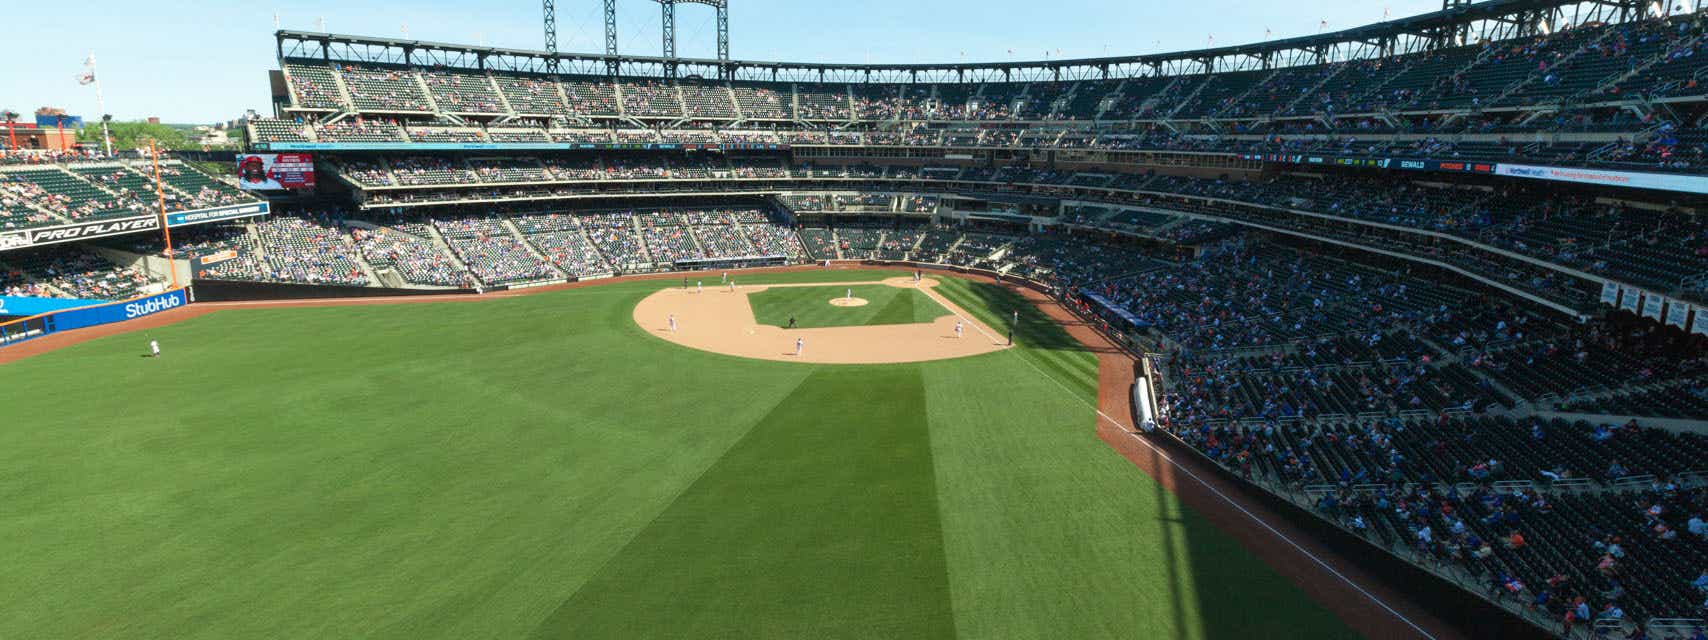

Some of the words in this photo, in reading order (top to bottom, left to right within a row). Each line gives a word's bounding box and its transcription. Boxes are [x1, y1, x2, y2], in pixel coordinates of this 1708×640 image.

[33, 227, 80, 242] PRO
[81, 217, 157, 236] PLAYER
[125, 294, 180, 318] StubHub
